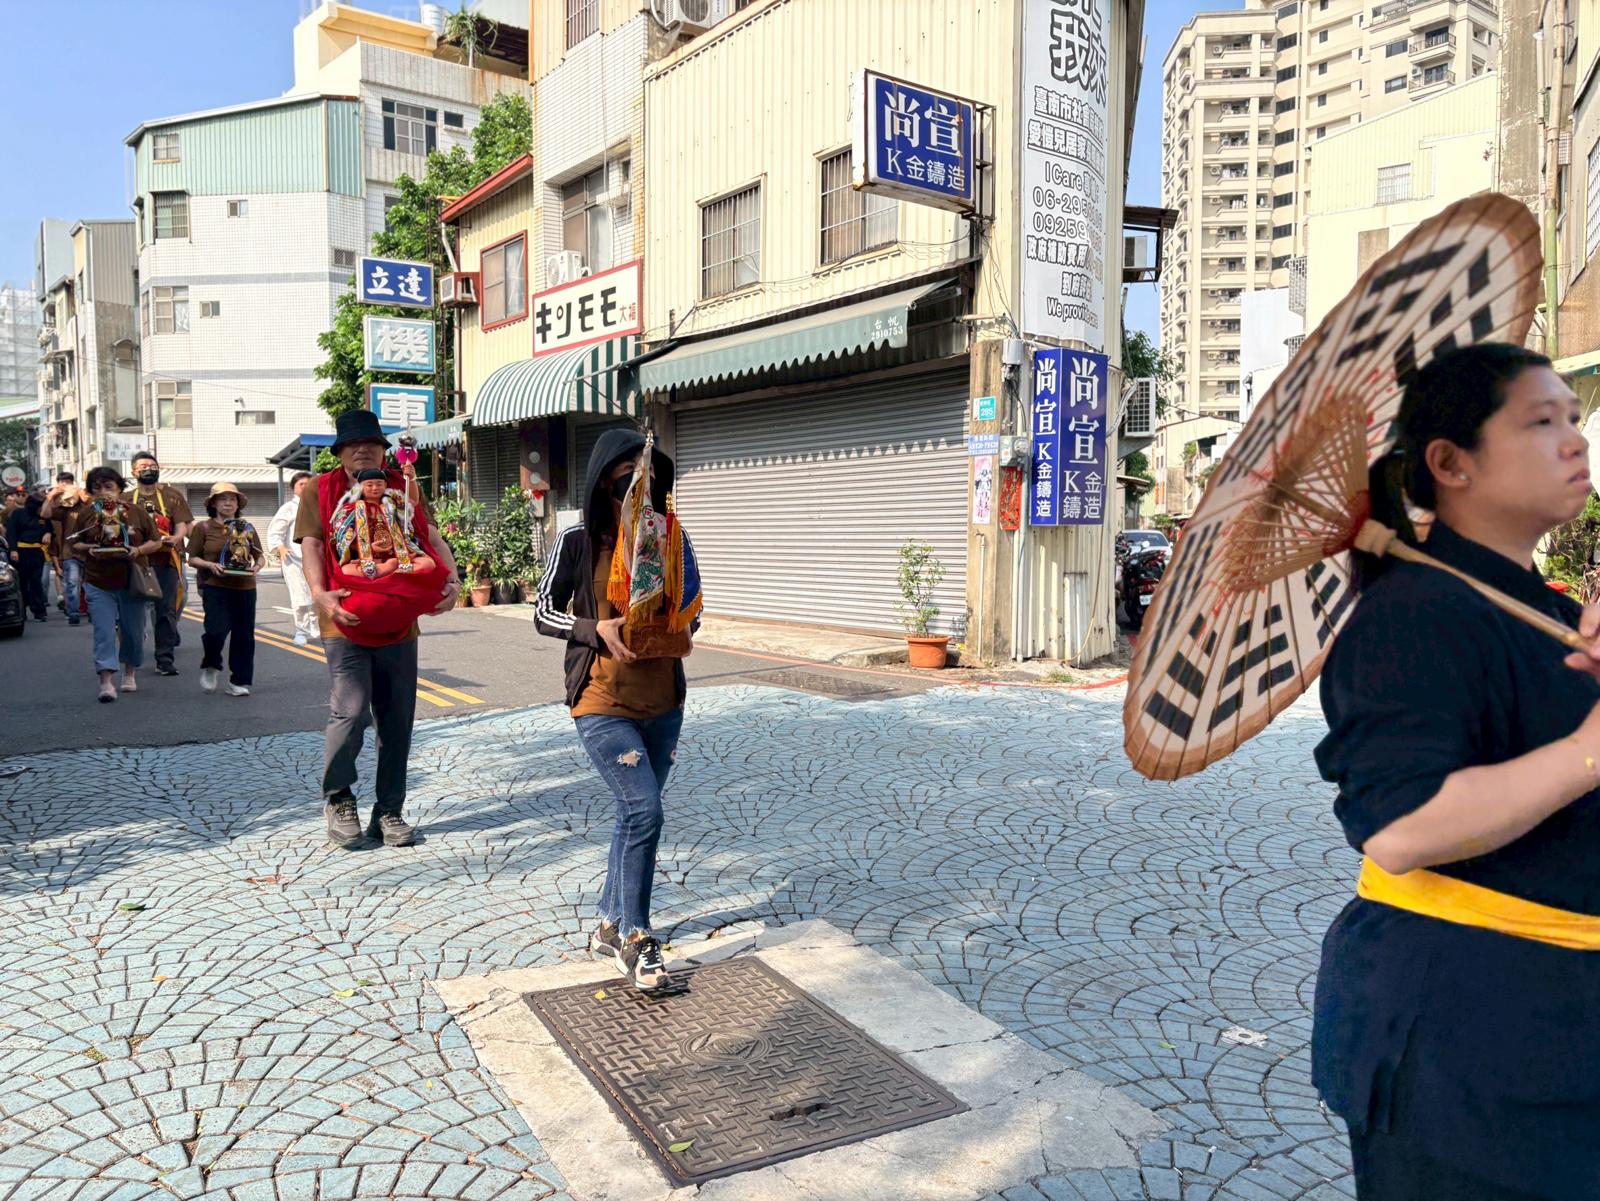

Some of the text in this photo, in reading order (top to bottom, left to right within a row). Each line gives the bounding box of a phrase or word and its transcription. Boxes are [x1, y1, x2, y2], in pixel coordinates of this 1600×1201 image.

[884, 91, 963, 157] 尚宣
[886, 147, 965, 191] K金鑄造
[1052, 163, 1083, 192] Care
[367, 266, 427, 302] 立達
[1047, 296, 1062, 318] We
[1068, 357, 1100, 465] 尚宣
